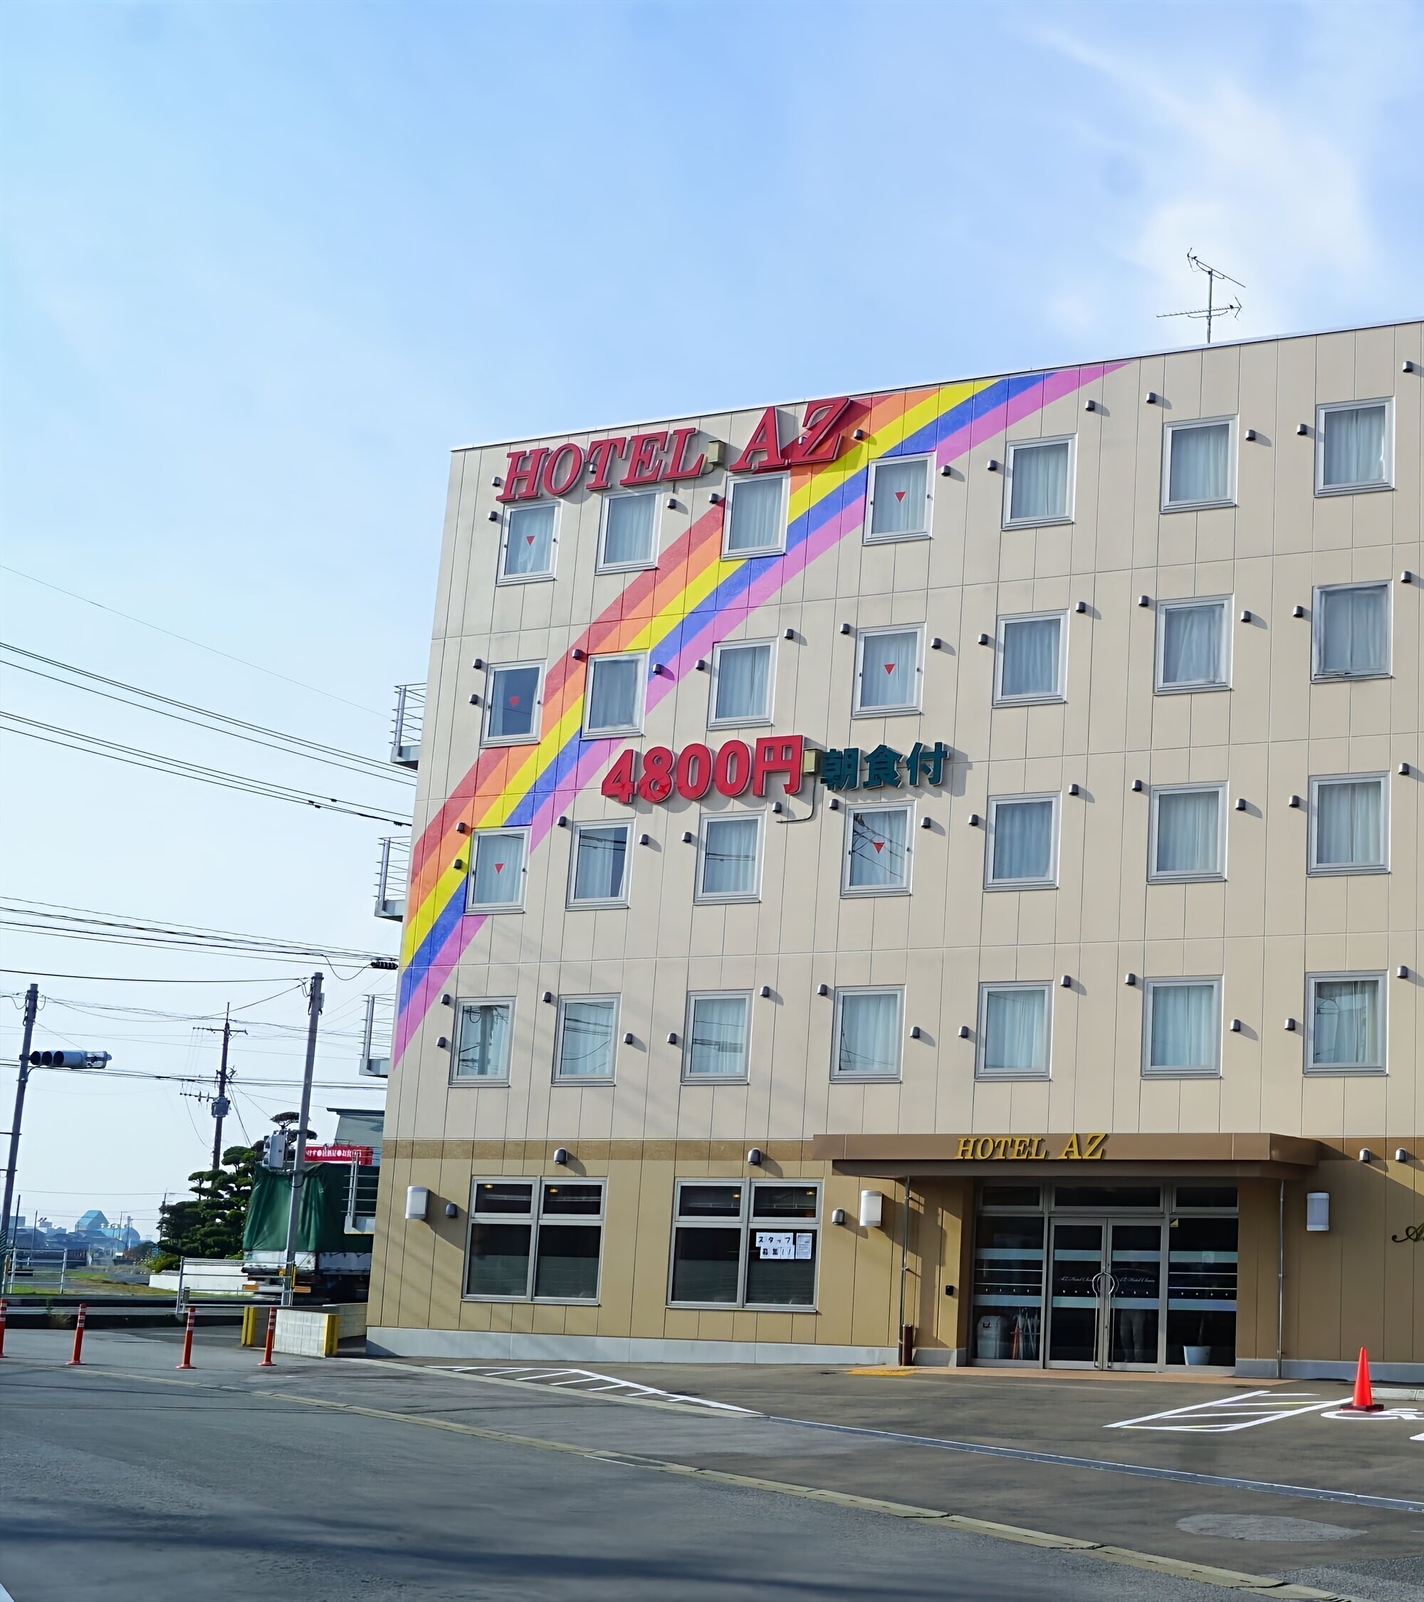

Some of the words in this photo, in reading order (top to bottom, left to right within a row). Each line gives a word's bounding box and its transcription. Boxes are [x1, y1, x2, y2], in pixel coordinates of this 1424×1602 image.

[496, 428, 706, 502] HOTEL
[729, 397, 850, 473] AZ
[601, 735, 804, 803] 4800円
[821, 741, 949, 791] 朝食付
[954, 1137, 1048, 1160] HOTEL
[1057, 1133, 1107, 1160] AZ
[758, 1236, 791, 1244] スタッフ
